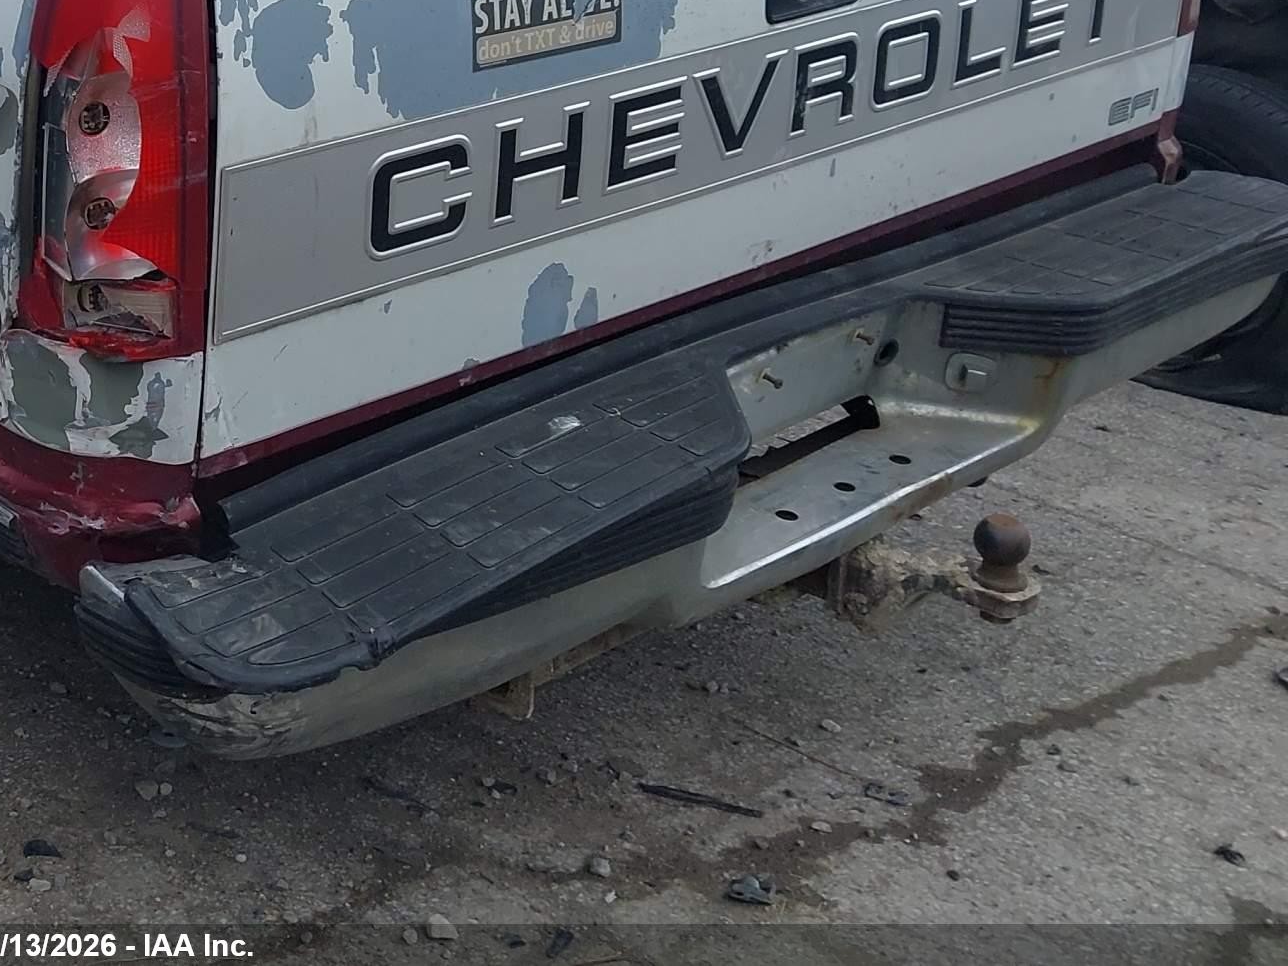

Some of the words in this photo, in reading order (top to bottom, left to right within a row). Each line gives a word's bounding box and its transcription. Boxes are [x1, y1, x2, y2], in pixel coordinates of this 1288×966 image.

[479, 36, 522, 62] don't
[524, 28, 556, 51] TXT
[559, 25, 571, 45] &
[575, 18, 615, 42] drive
[1108, 88, 1159, 126] EFI
